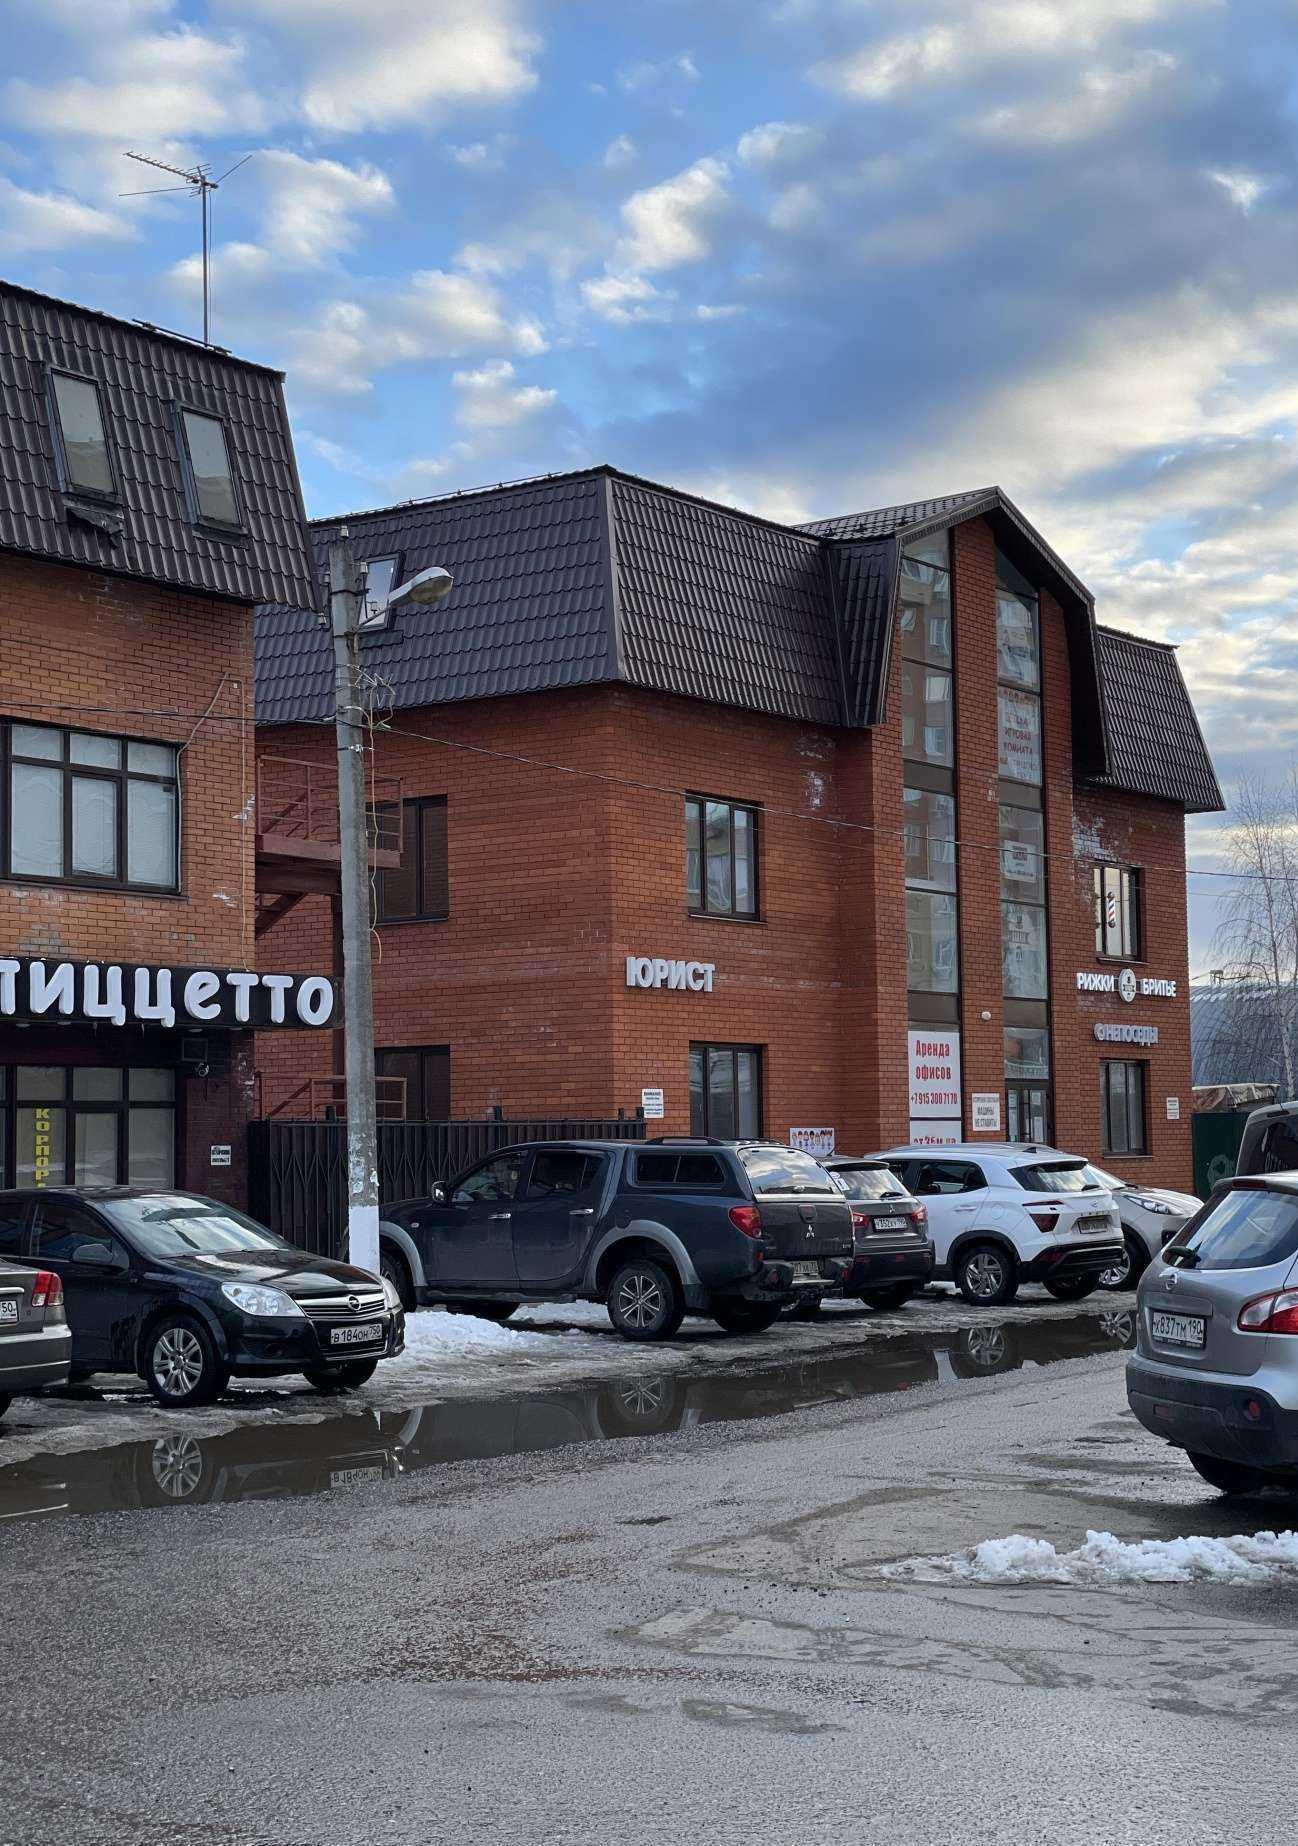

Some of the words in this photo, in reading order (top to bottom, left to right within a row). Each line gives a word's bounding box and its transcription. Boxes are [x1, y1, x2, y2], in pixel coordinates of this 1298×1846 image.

[626, 956, 716, 992] ЮРИСТ
[1141, 978, 1177, 997] БРИТЬЕ
[915, 1039, 950, 1058] Аренда
[915, 1065, 952, 1081] офисов
[2, 1302, 13, 1313] 50
